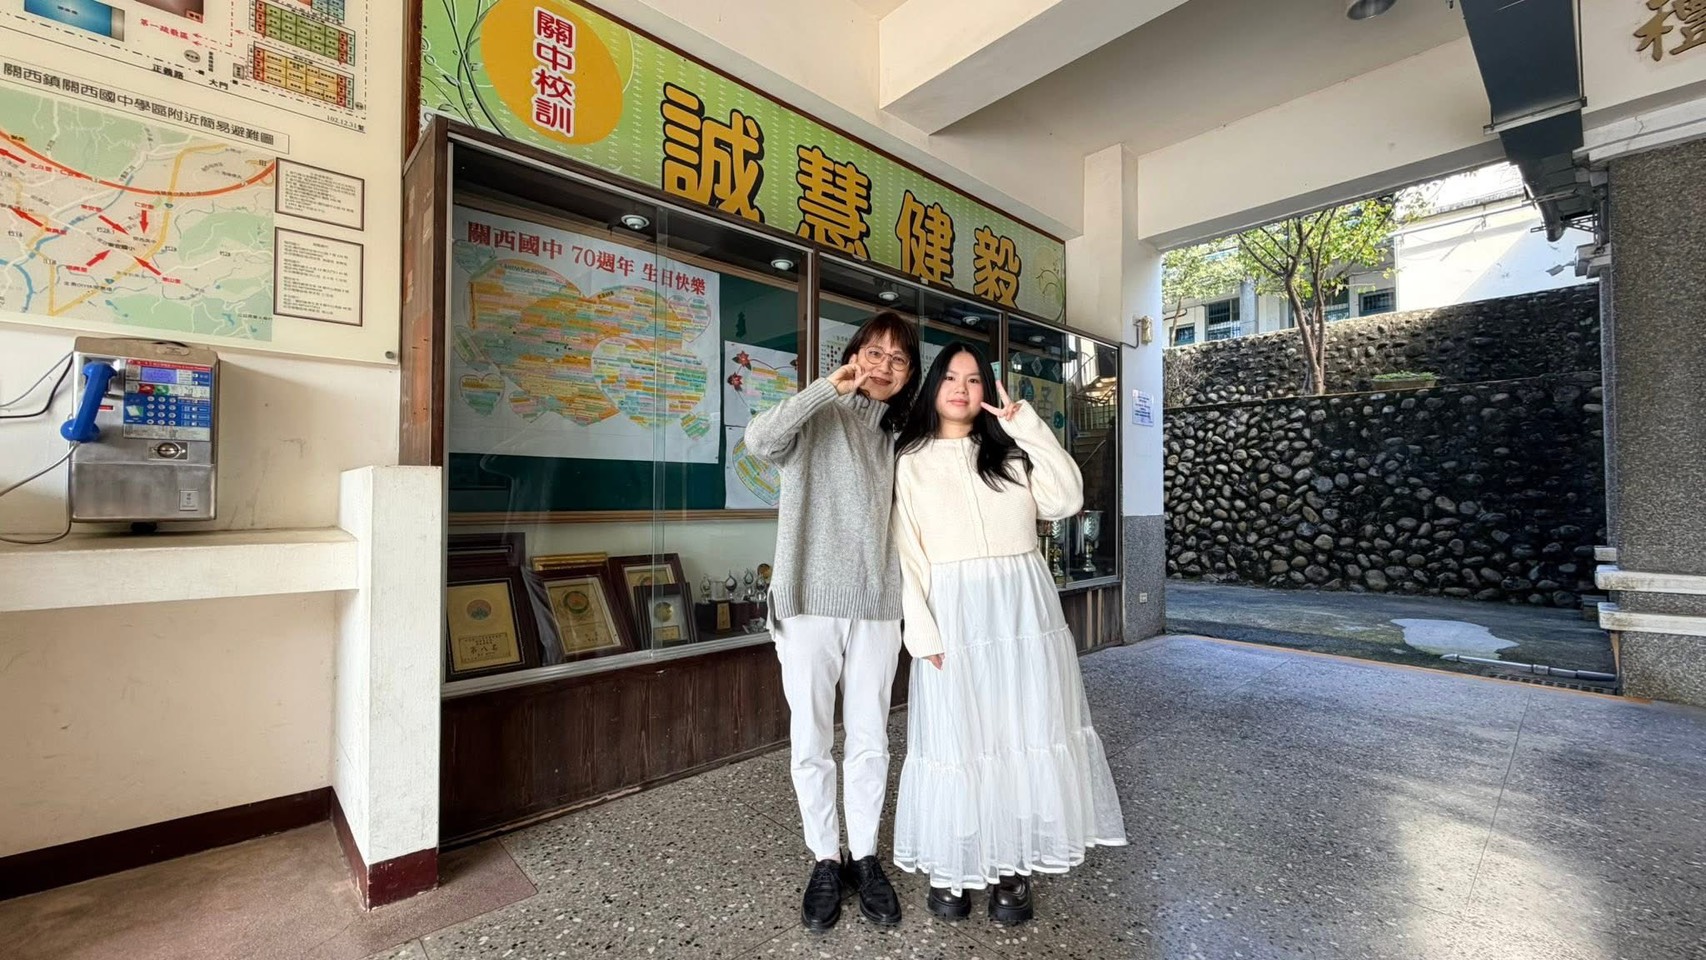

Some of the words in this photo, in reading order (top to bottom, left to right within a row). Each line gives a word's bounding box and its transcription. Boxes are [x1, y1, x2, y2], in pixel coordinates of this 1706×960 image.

[3, 62, 274, 147] 關西鎮關西國中學區附近簡易避難圖
[535, 9, 573, 134] 關中校訓
[467, 221, 563, 260] 關西國中
[571, 245, 635, 277] 70週年
[641, 263, 706, 296] 生日快樂
